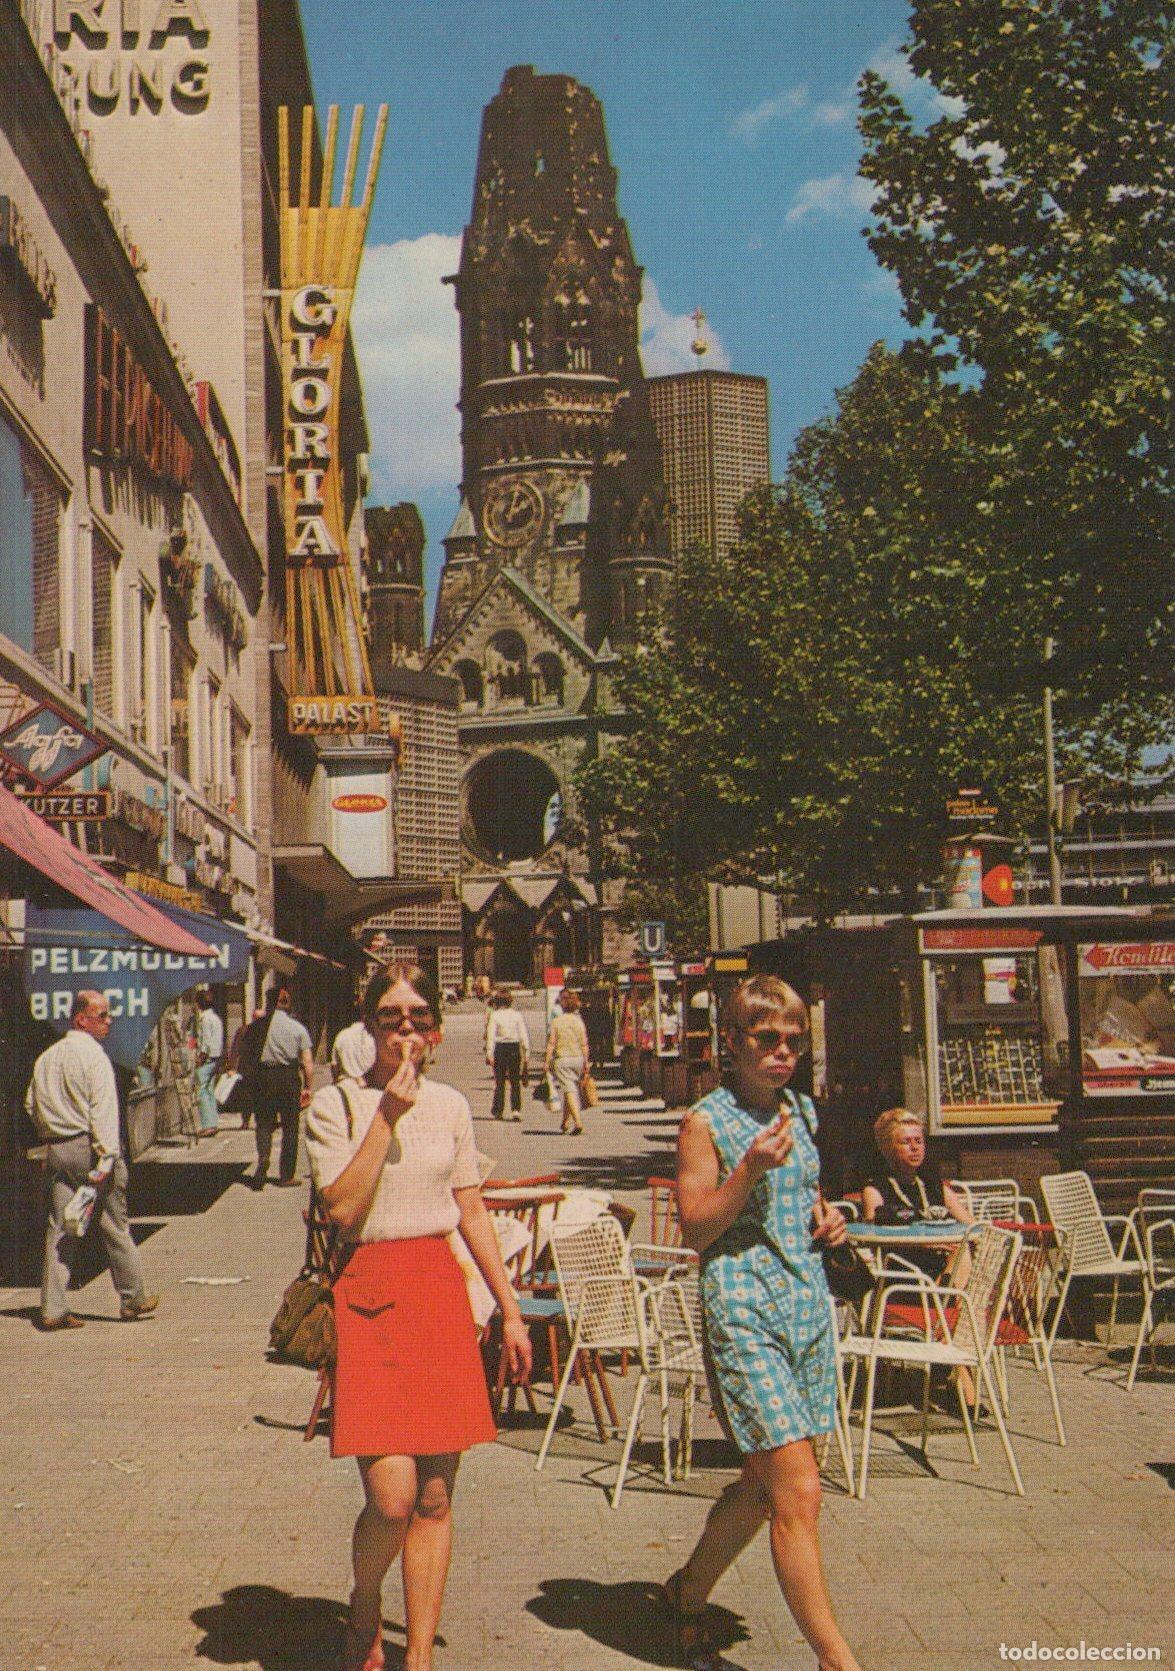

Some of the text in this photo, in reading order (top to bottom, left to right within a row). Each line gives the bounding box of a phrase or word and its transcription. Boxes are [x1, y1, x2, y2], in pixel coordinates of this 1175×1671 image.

[288, 284, 341, 567] GLORIA
[293, 702, 372, 726] PALAST
[3, 723, 85, 771] Agfa
[643, 926, 661, 951] U
[30, 987, 149, 1020] BRCH
